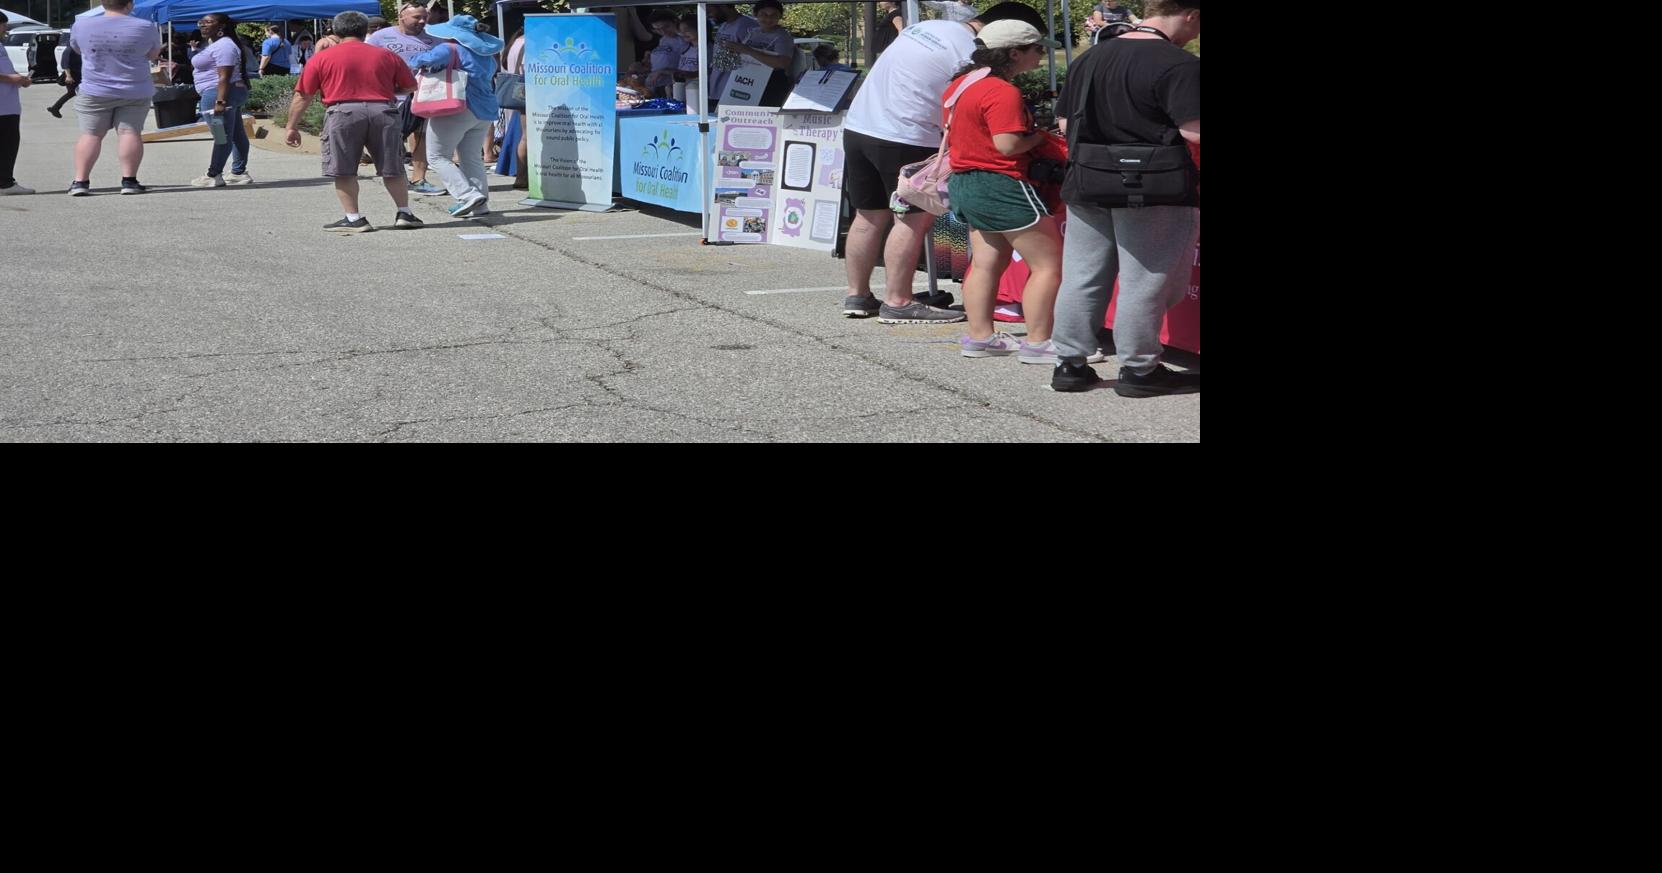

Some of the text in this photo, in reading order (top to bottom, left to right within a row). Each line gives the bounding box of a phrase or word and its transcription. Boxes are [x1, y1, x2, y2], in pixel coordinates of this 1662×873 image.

[528, 62, 612, 74] Missouri Coalition
[534, 75, 604, 86] for Oral Health
[725, 109, 775, 117] Communi
[803, 113, 832, 125] Music
[800, 125, 838, 142] Therapy
[633, 161, 659, 179] Missouri
